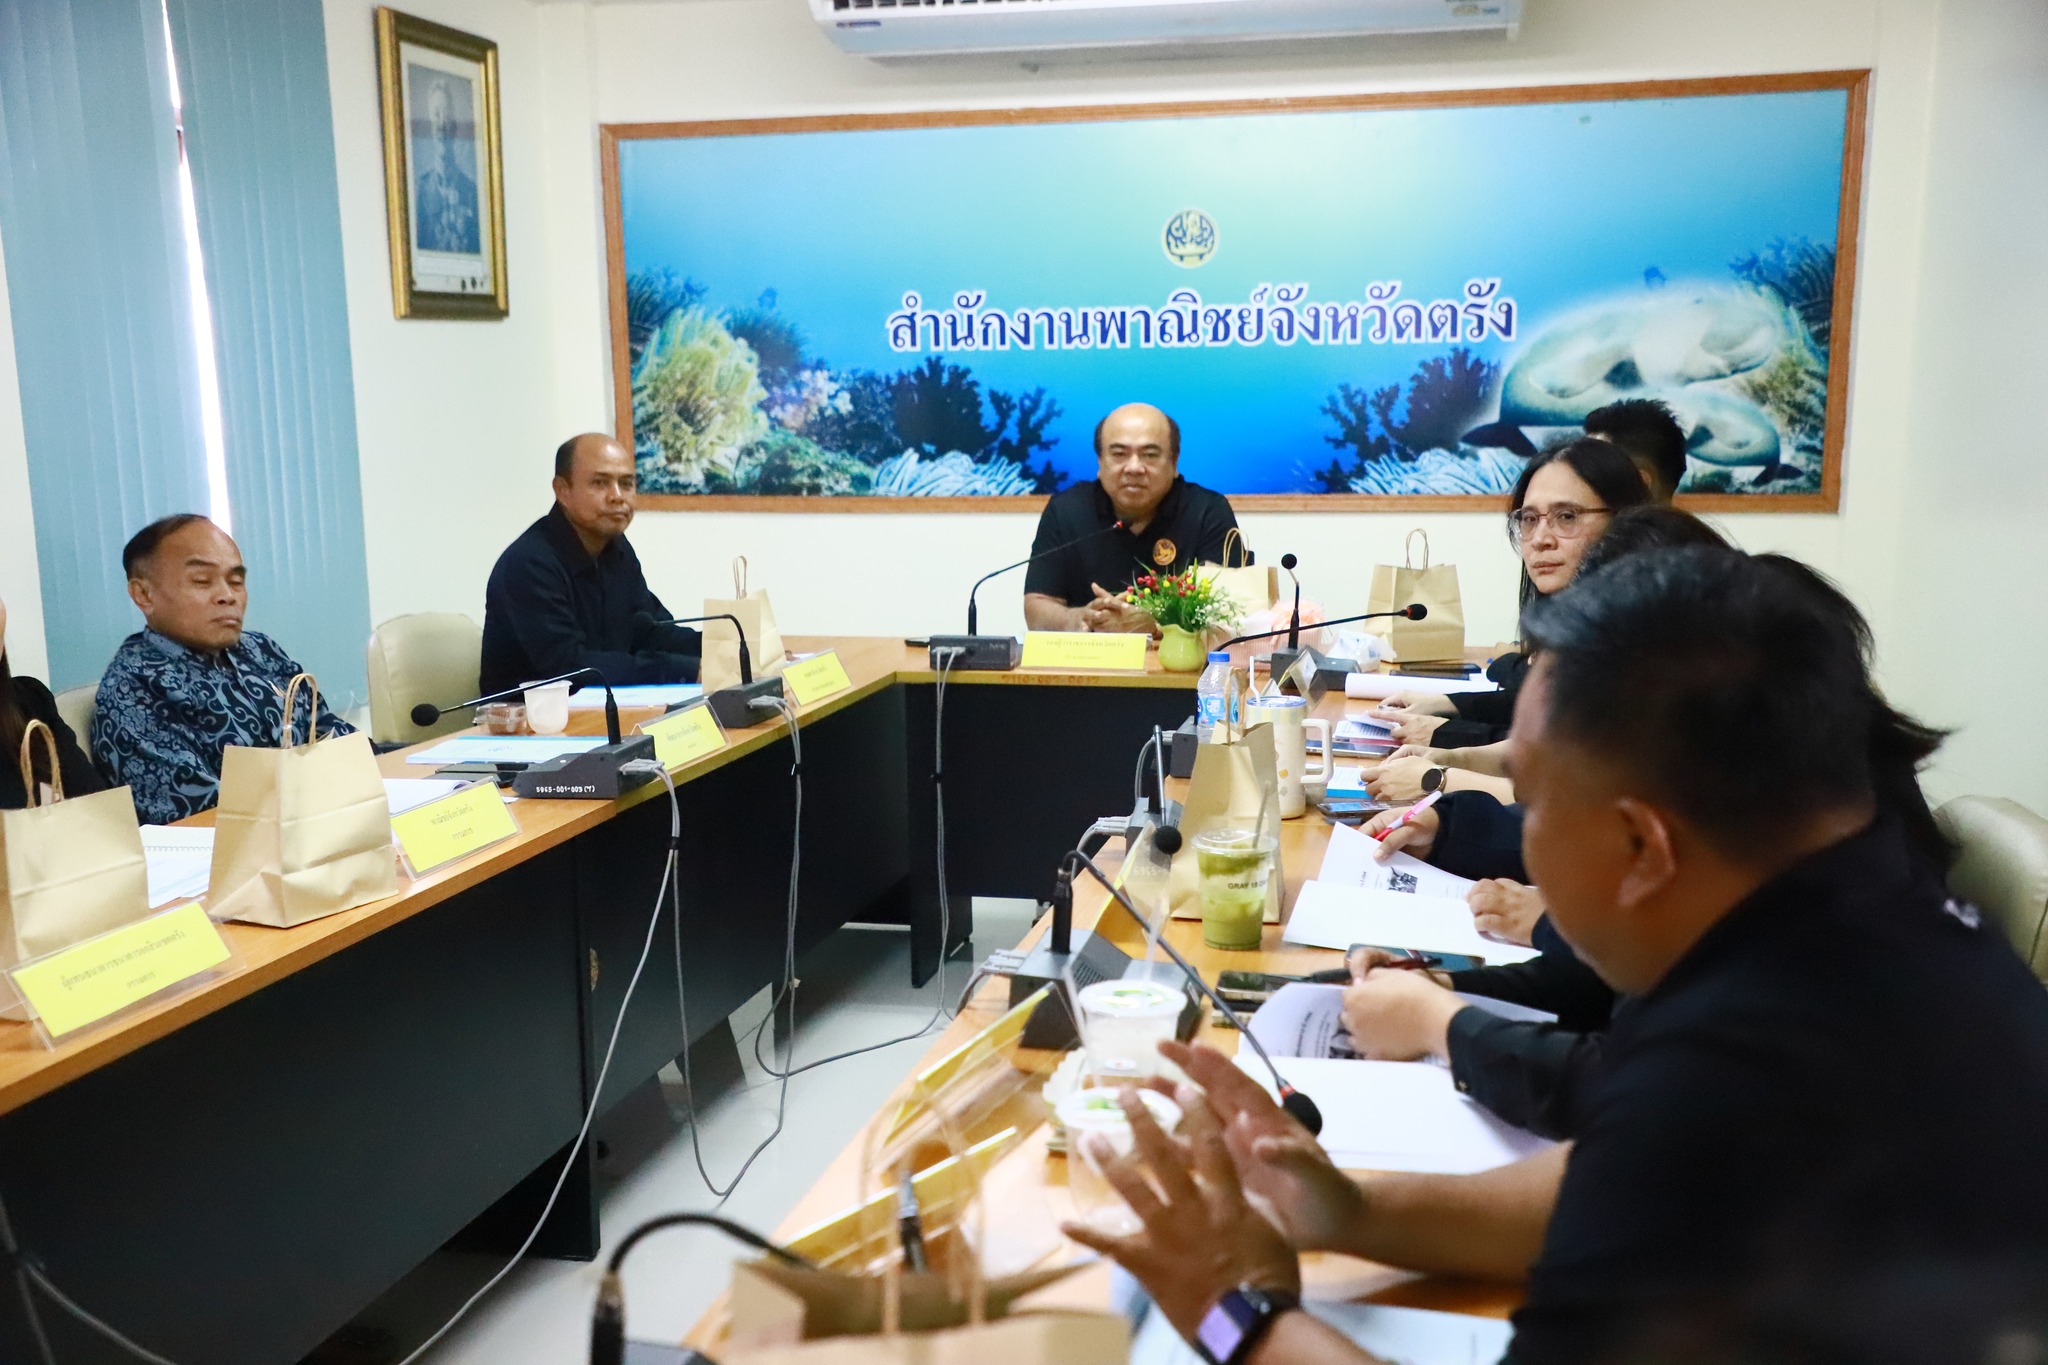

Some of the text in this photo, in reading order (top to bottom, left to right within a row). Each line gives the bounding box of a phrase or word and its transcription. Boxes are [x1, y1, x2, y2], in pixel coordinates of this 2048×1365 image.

[888, 281, 1515, 349] สำนักงานพาณิชย์จังหวัดตรัง
